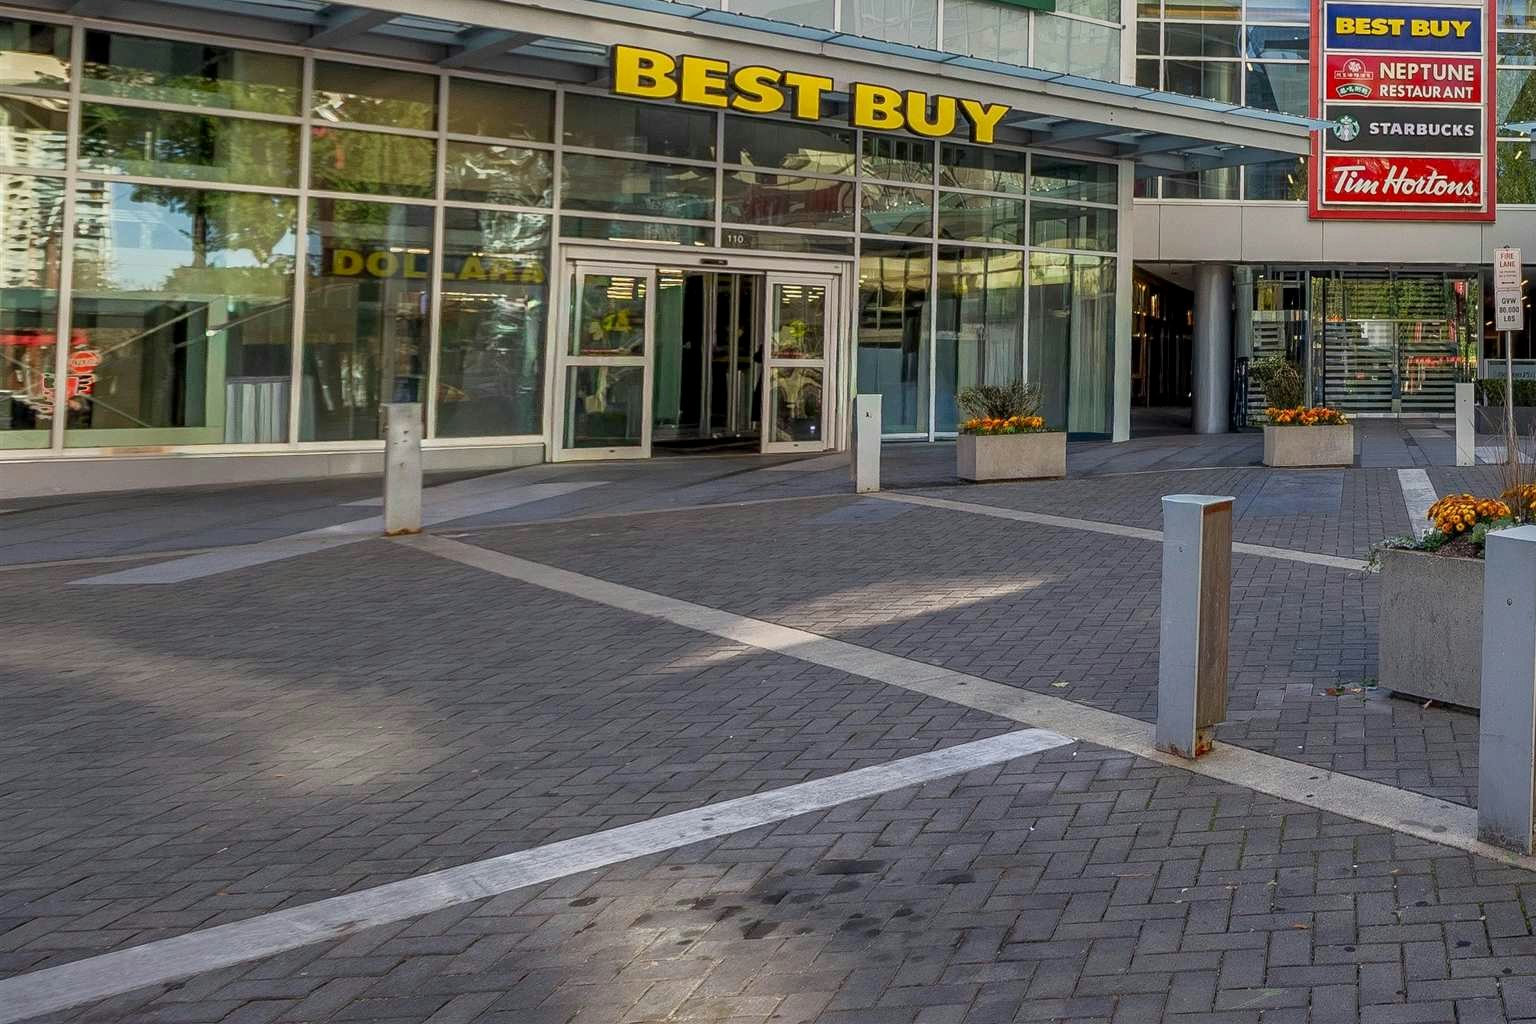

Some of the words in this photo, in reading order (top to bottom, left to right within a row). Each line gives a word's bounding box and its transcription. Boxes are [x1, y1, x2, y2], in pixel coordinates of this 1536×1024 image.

[1335, 16, 1405, 36] BEST
[1411, 19, 1472, 38] BUY
[1379, 61, 1475, 82] NEPTUNE
[610, 43, 835, 122] BEST
[849, 82, 1012, 144] BUY
[1379, 83, 1474, 99] RESTAURANT
[1369, 121, 1475, 137] STARBUCKS
[1333, 164, 1379, 195] Tim
[1382, 165, 1475, 197] Hortons
[728, 234, 744, 244] 110
[1499, 260, 1516, 268] LANE
[1500, 252, 1514, 260] FIRE
